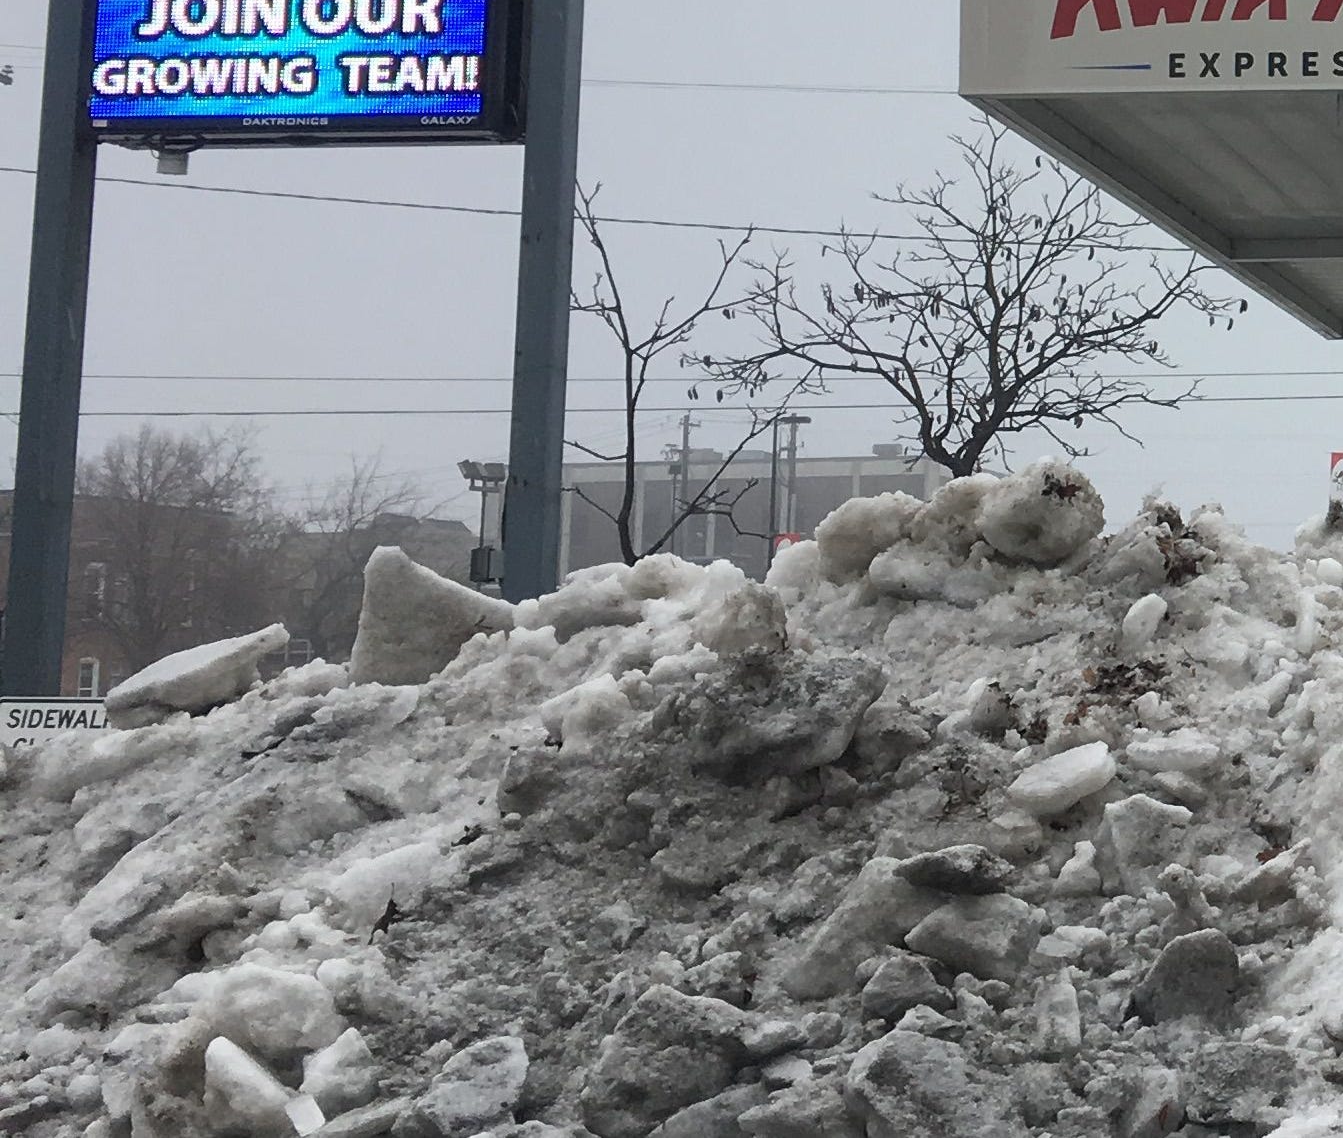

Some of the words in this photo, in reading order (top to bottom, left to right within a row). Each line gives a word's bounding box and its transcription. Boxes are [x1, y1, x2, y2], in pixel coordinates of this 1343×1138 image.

[92, 57, 315, 95] GROWING
[339, 56, 480, 94] TEAM!
[243, 117, 329, 126] DAKTRONICS
[420, 115, 474, 126] GALAXY
[7, 709, 109, 729] SIDEWAL
